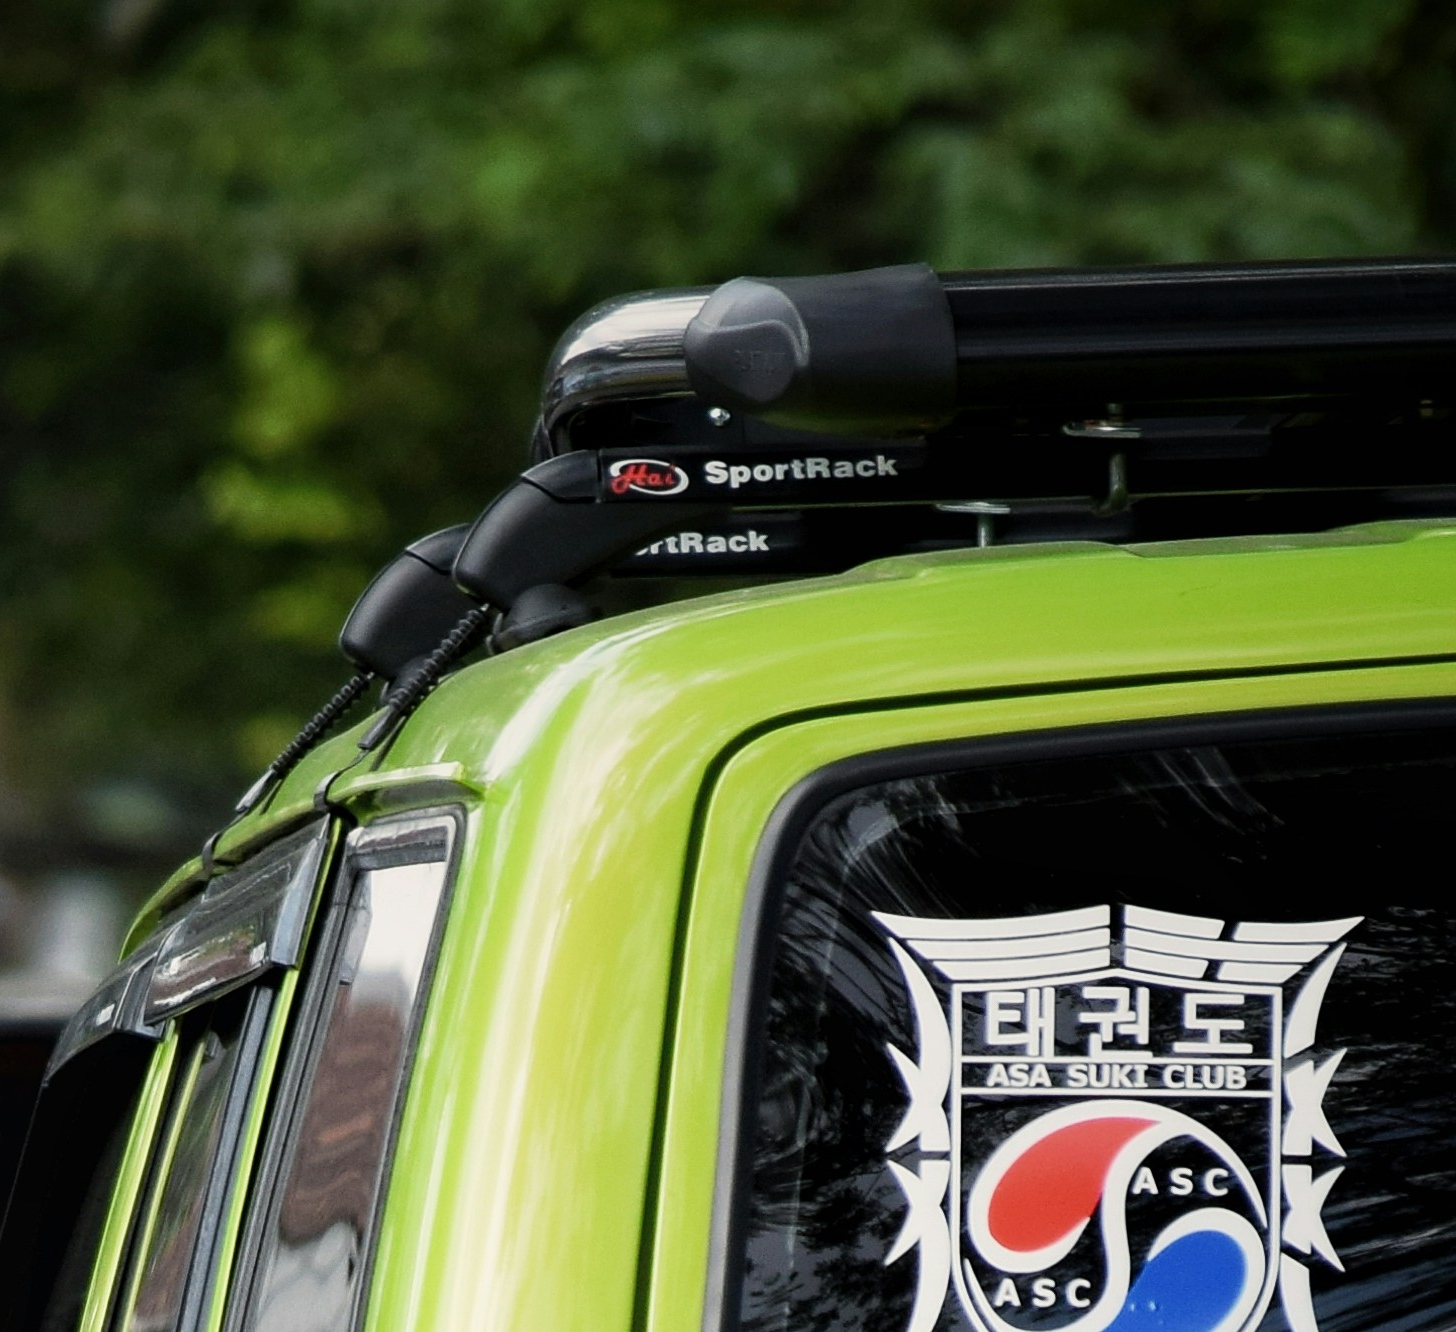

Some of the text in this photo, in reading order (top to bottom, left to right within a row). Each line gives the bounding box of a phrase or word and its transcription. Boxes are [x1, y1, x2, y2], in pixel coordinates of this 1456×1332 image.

[705, 455, 898, 488] SportRack
[635, 529, 770, 555] rtRack
[984, 985, 1254, 1060] 태권도
[986, 1063, 1248, 1091] ASA SUKI CLUB
[1133, 1167, 1229, 1196] ASC
[994, 1278, 1092, 1308] ASC
